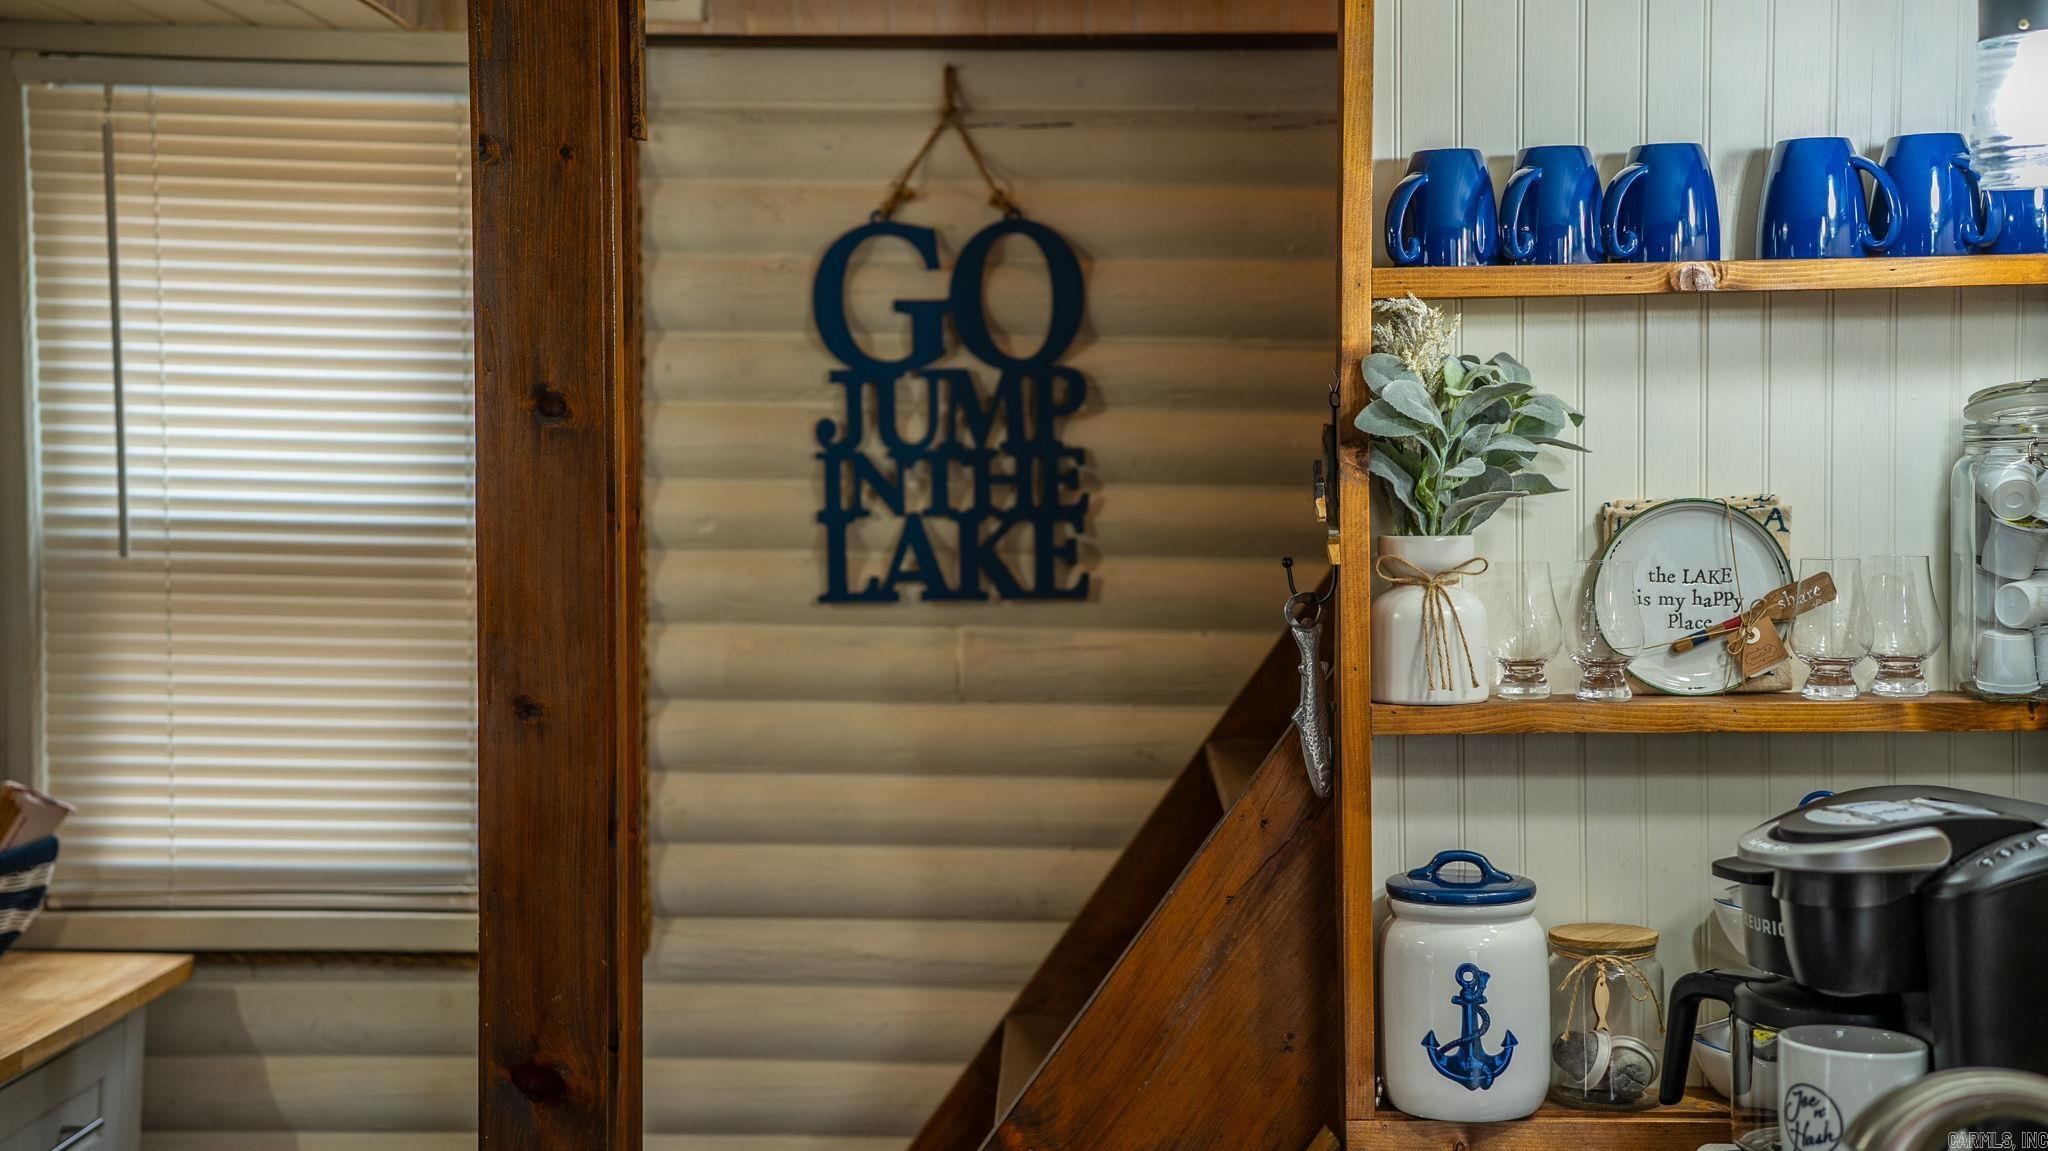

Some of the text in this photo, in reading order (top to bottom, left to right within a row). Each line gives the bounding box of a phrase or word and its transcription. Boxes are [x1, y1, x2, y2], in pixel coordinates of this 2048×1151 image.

[813, 218, 1086, 371] GO
[815, 368, 1087, 451] JUMP
[816, 510, 1090, 603] LAKE
[1648, 566, 1733, 584] the LAKE
[1637, 589, 1651, 606] is
[1658, 595, 1686, 612] my
[1778, 585, 1822, 609] share
[1785, 1090, 1820, 1121] Joe
[1790, 1120, 1840, 1151] Hash
